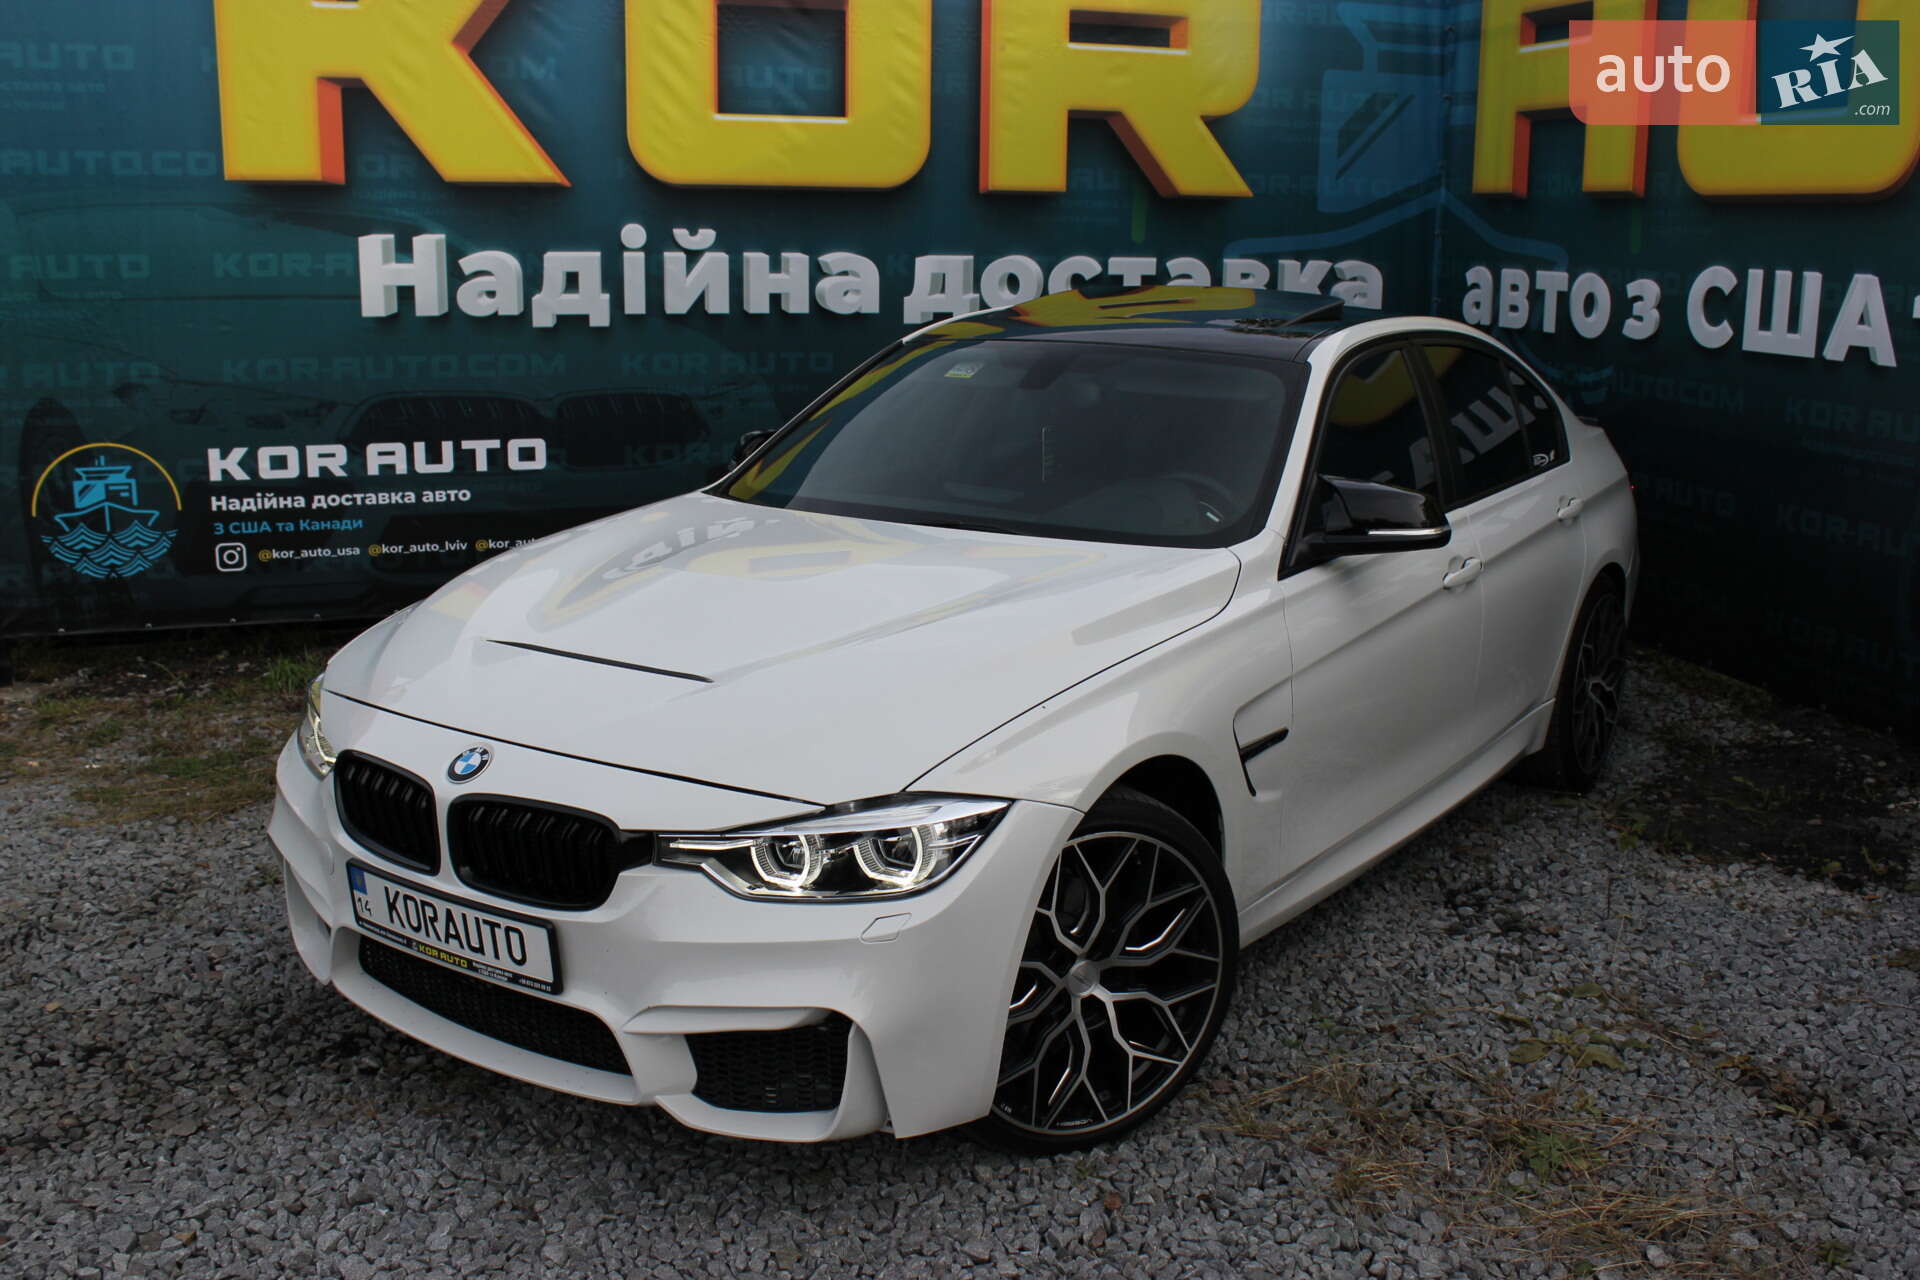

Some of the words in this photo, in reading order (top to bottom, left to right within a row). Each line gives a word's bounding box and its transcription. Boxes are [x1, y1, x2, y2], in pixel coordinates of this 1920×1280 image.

[213, 0, 1260, 197] KOR
[358, 223, 881, 328] Надійна
[903, 254, 1384, 324] доставка
[1461, 265, 1612, 341] авто
[1686, 265, 1898, 369] США
[207, 443, 348, 483] KOR
[366, 438, 547, 477] AUTO
[211, 491, 306, 512] Надійна
[311, 489, 417, 510] доставка
[422, 487, 472, 504] авто
[229, 521, 272, 535] США
[275, 522, 295, 533] та
[299, 518, 364, 534] Канади
[258, 546, 361, 563] @kor_auto_usa
[368, 539, 469, 558] @kor_auto_lviv
[384, 885, 527, 967] KORAUTO
[419, 943, 440, 959] KOR
[439, 953, 469, 970] AUTO
